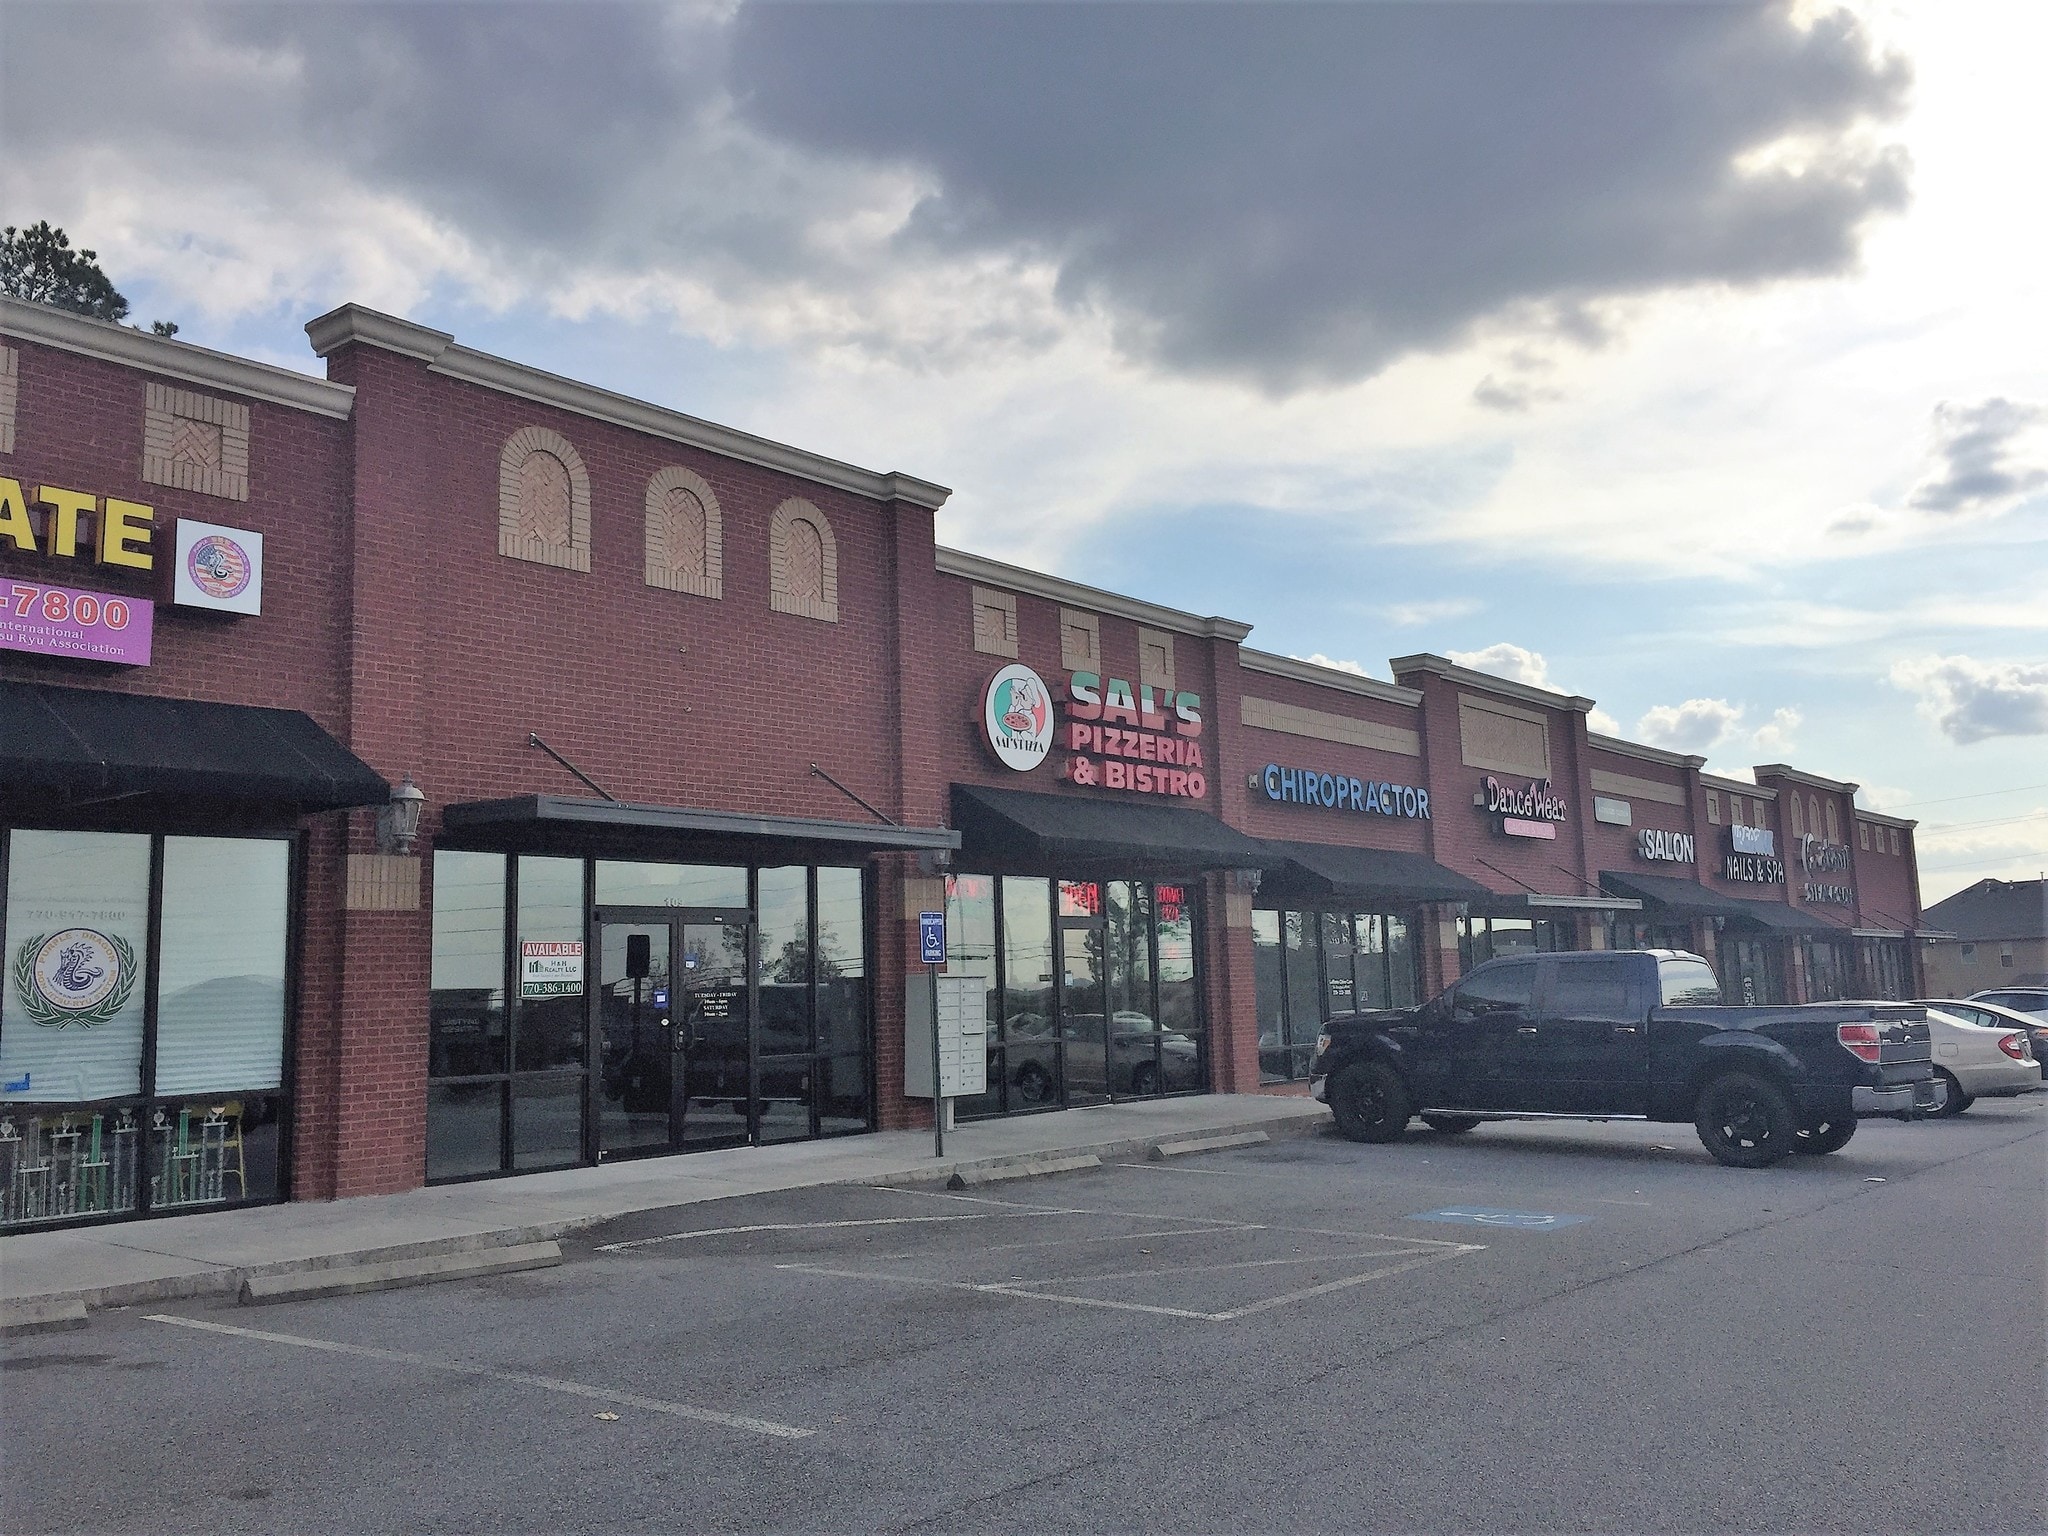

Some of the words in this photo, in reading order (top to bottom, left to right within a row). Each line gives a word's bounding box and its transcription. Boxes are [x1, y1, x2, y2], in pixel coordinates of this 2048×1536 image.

[0, 475, 154, 570] ATE
[19, 634, 44, 647] Ryu
[49, 638, 125, 656] Association
[1070, 670, 1202, 738] SAL'S
[1072, 722, 1203, 768] PIZZERIA
[1073, 756, 1096, 786] &
[1105, 760, 1206, 799] BISTRO
[1264, 763, 1431, 819] CHIROPRACTOR
[1644, 828, 1695, 863] SALON
[1726, 855, 1754, 882] NAILS
[1756, 858, 1764, 882] &
[1766, 860, 1785, 884] SPA
[38, 931, 72, 964] PURPLE
[81, 931, 117, 964] DRAGON
[524, 943, 581, 956] AVAILABLE
[523, 982, 581, 994] 770-386-1400
